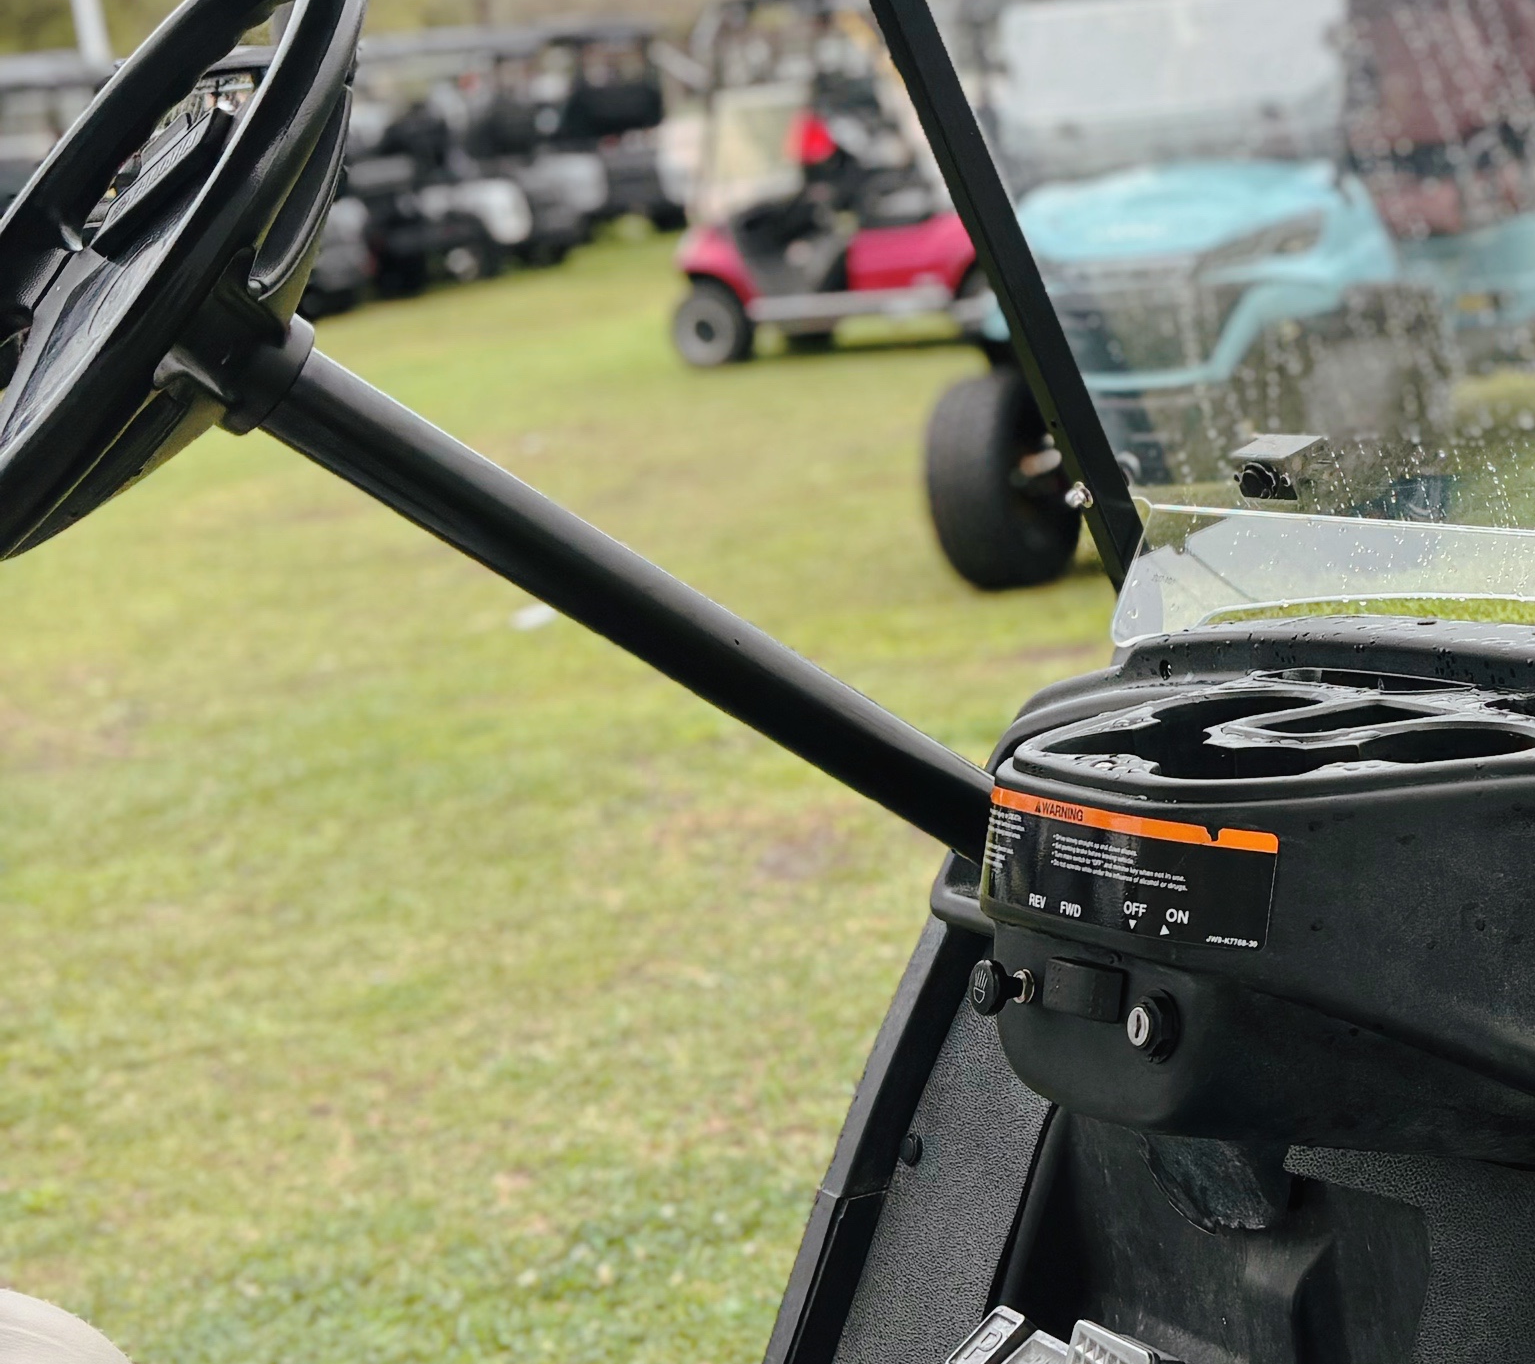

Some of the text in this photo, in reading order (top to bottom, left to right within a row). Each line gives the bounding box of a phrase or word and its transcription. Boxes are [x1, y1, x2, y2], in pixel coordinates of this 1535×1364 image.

[1042, 802, 1084, 822] WARNING
[1028, 892, 1082, 918] REV FWD
[1123, 900, 1190, 925] OFF ON
[963, 1327, 1003, 1361] P
